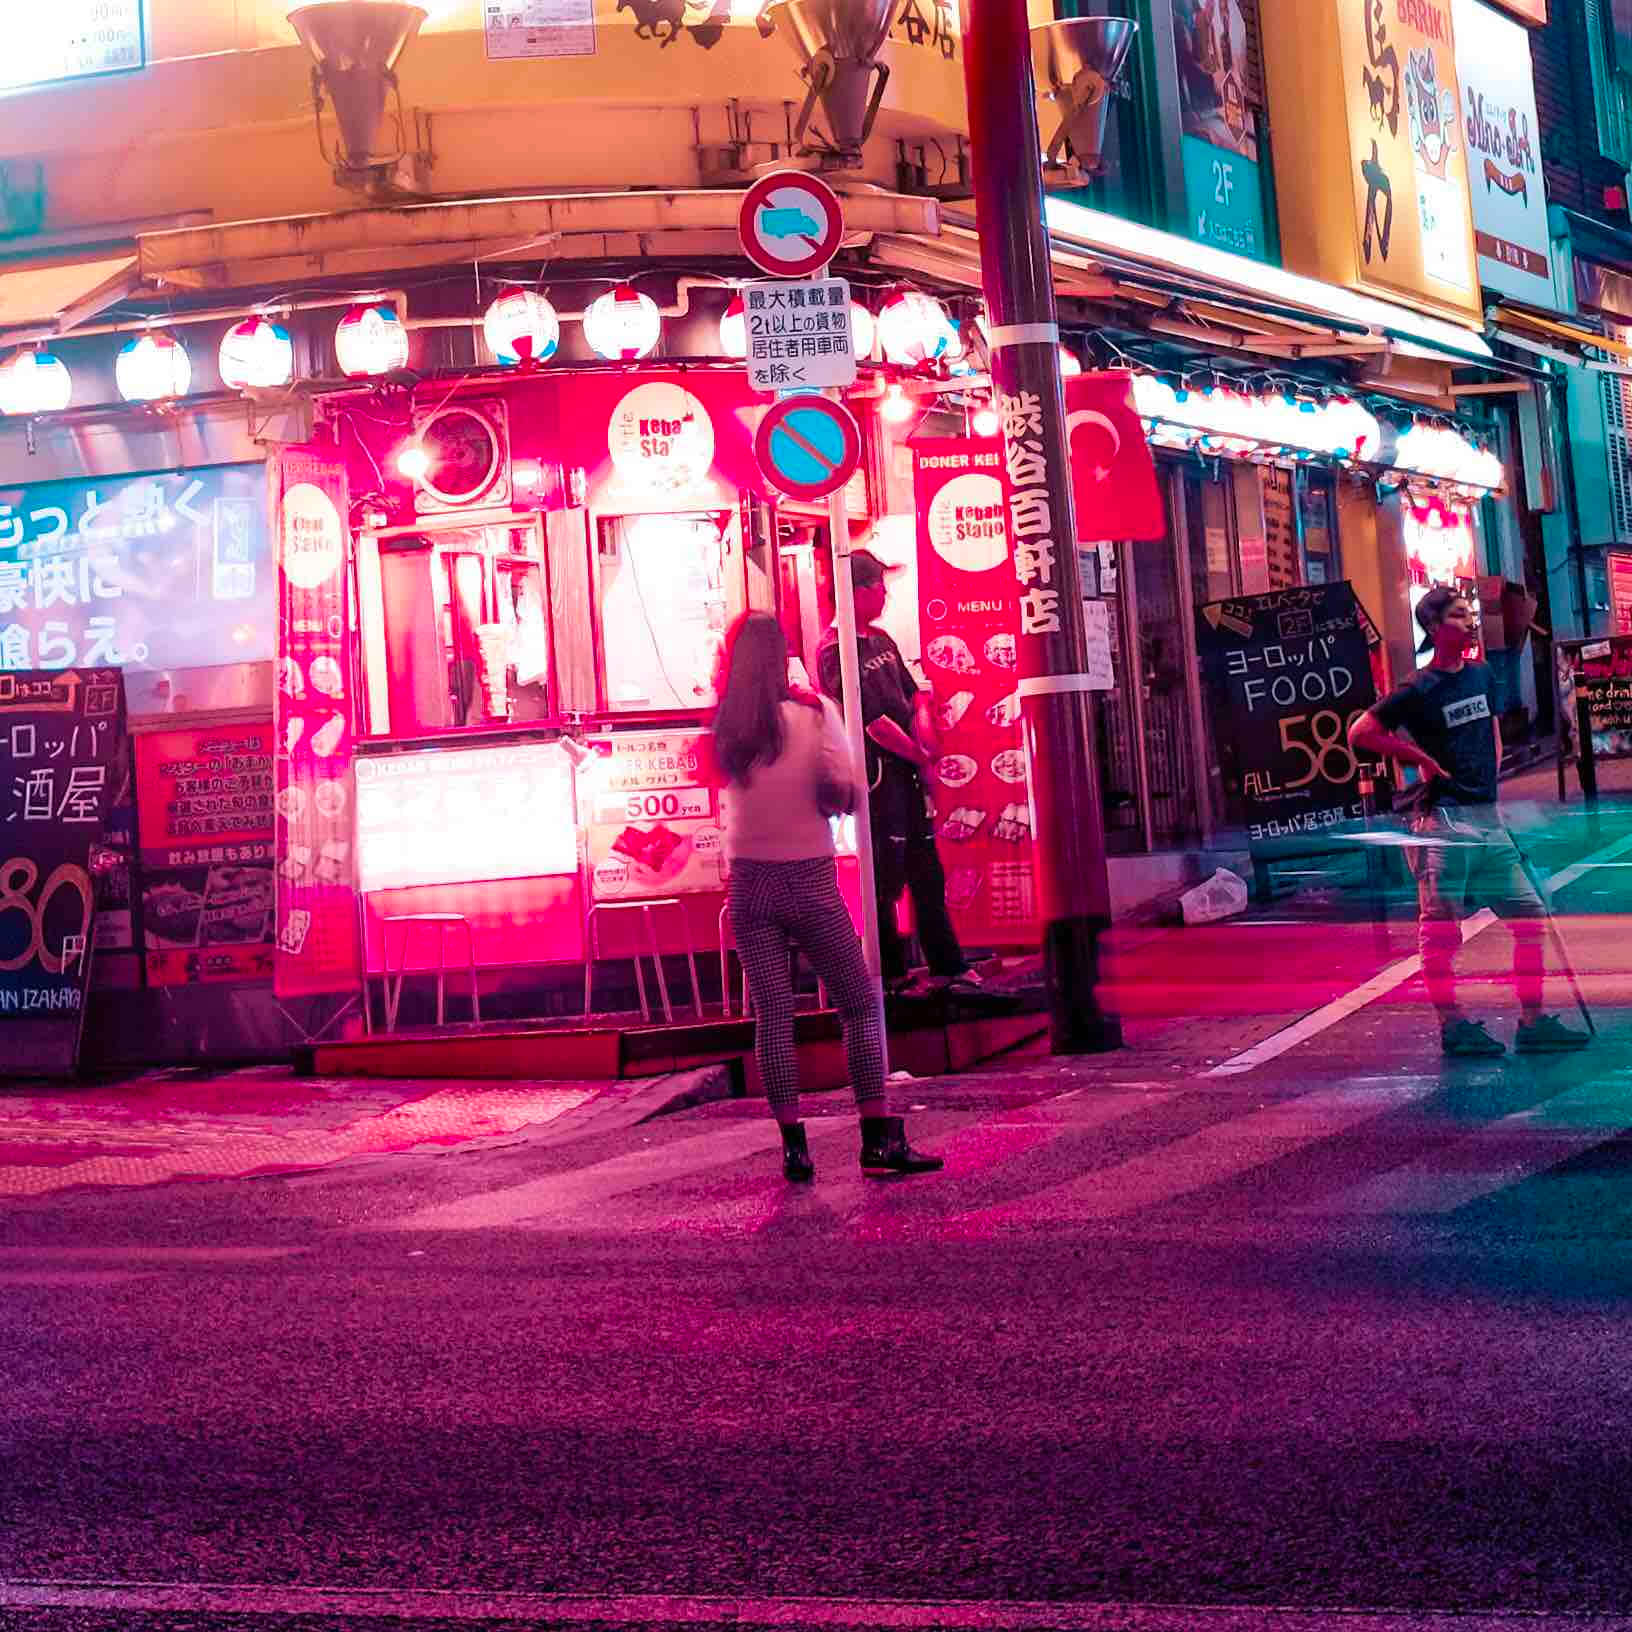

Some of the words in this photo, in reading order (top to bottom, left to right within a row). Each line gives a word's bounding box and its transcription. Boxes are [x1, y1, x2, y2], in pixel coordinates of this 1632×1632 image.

[1213, 158, 1234, 208] 2F
[748, 287, 847, 311] 最大積載量
[751, 313, 848, 338] 2t以上の貨物
[750, 335, 850, 359] 居住者用車両
[754, 363, 806, 385] を除く
[1000, 390, 1062, 636] 渋谷百軒店
[956, 520, 1005, 540] Statio
[957, 600, 1003, 613] MENU
[1226, 634, 1337, 675] ヨーロッパ
[1244, 667, 1353, 713] FOOD
[1279, 709, 1367, 788] 58
[1244, 770, 1282, 797] ALL
[627, 793, 679, 817] 500
[681, 804, 702, 815] yen
[60, 934, 87, 977] 円
[22, 987, 82, 1011] IZAKAYA
